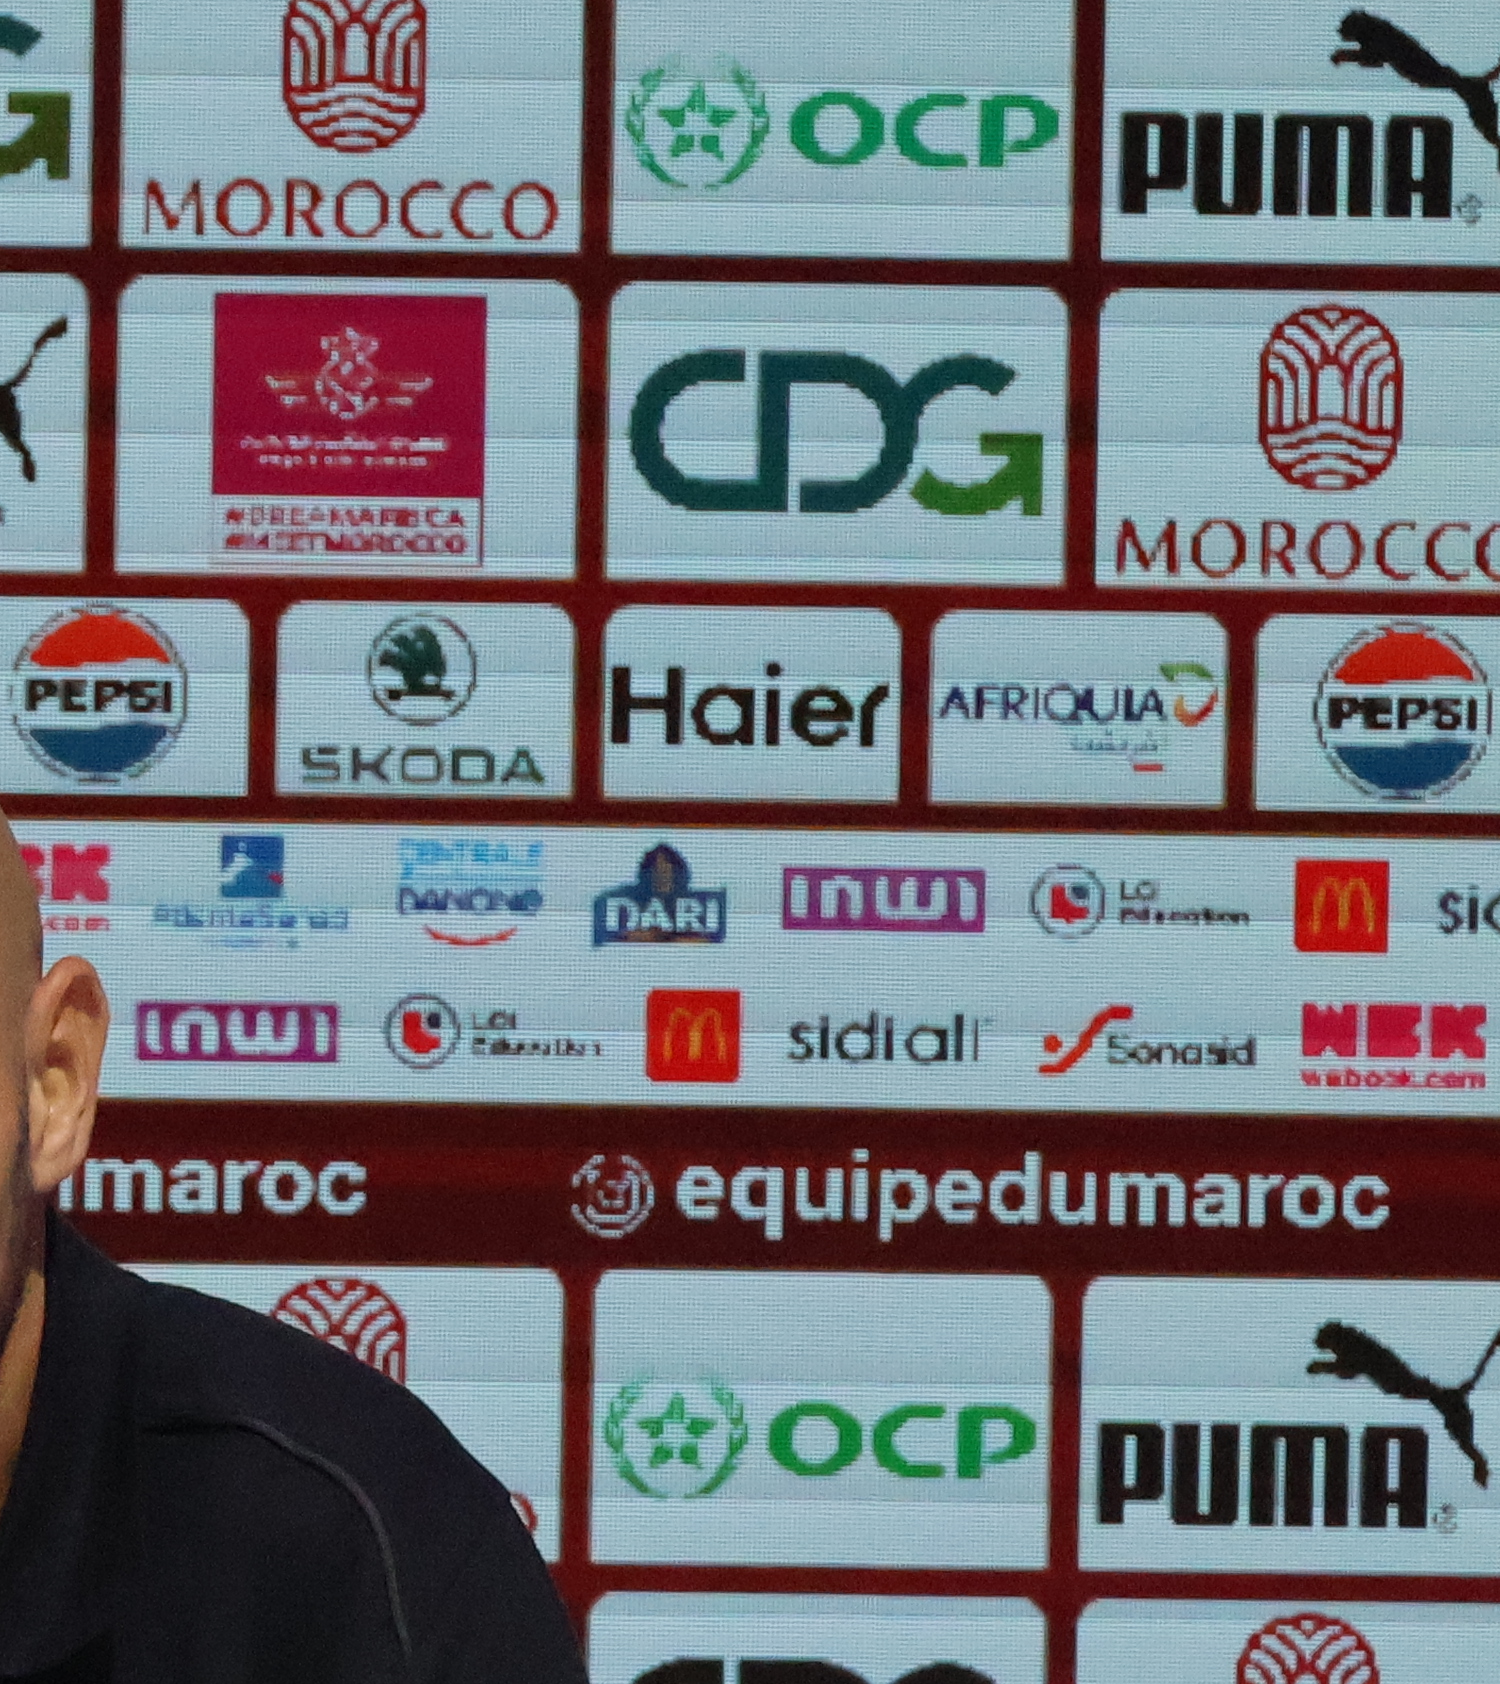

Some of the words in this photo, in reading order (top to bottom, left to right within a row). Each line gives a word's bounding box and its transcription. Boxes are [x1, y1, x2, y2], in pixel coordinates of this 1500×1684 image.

[789, 91, 1059, 169] OCP
[1119, 112, 1453, 218] PUMA
[145, 178, 559, 240] MOROCCO
[629, 349, 1043, 516] CDG
[26, 679, 172, 713] PEPSI
[601, 662, 889, 747] Haier
[940, 684, 1165, 723] AFRIQUIA
[1328, 697, 1477, 731] PEPSI
[398, 887, 542, 913] DANONE
[605, 895, 720, 936] DARI
[790, 873, 974, 923] inwi
[144, 1007, 329, 1056] inwi
[1108, 1035, 1255, 1066] Sonasid
[676, 1151, 1389, 1240] equipedumaroc
[768, 1402, 1036, 1479] OCP
[1097, 1422, 1428, 1528] PUMA
